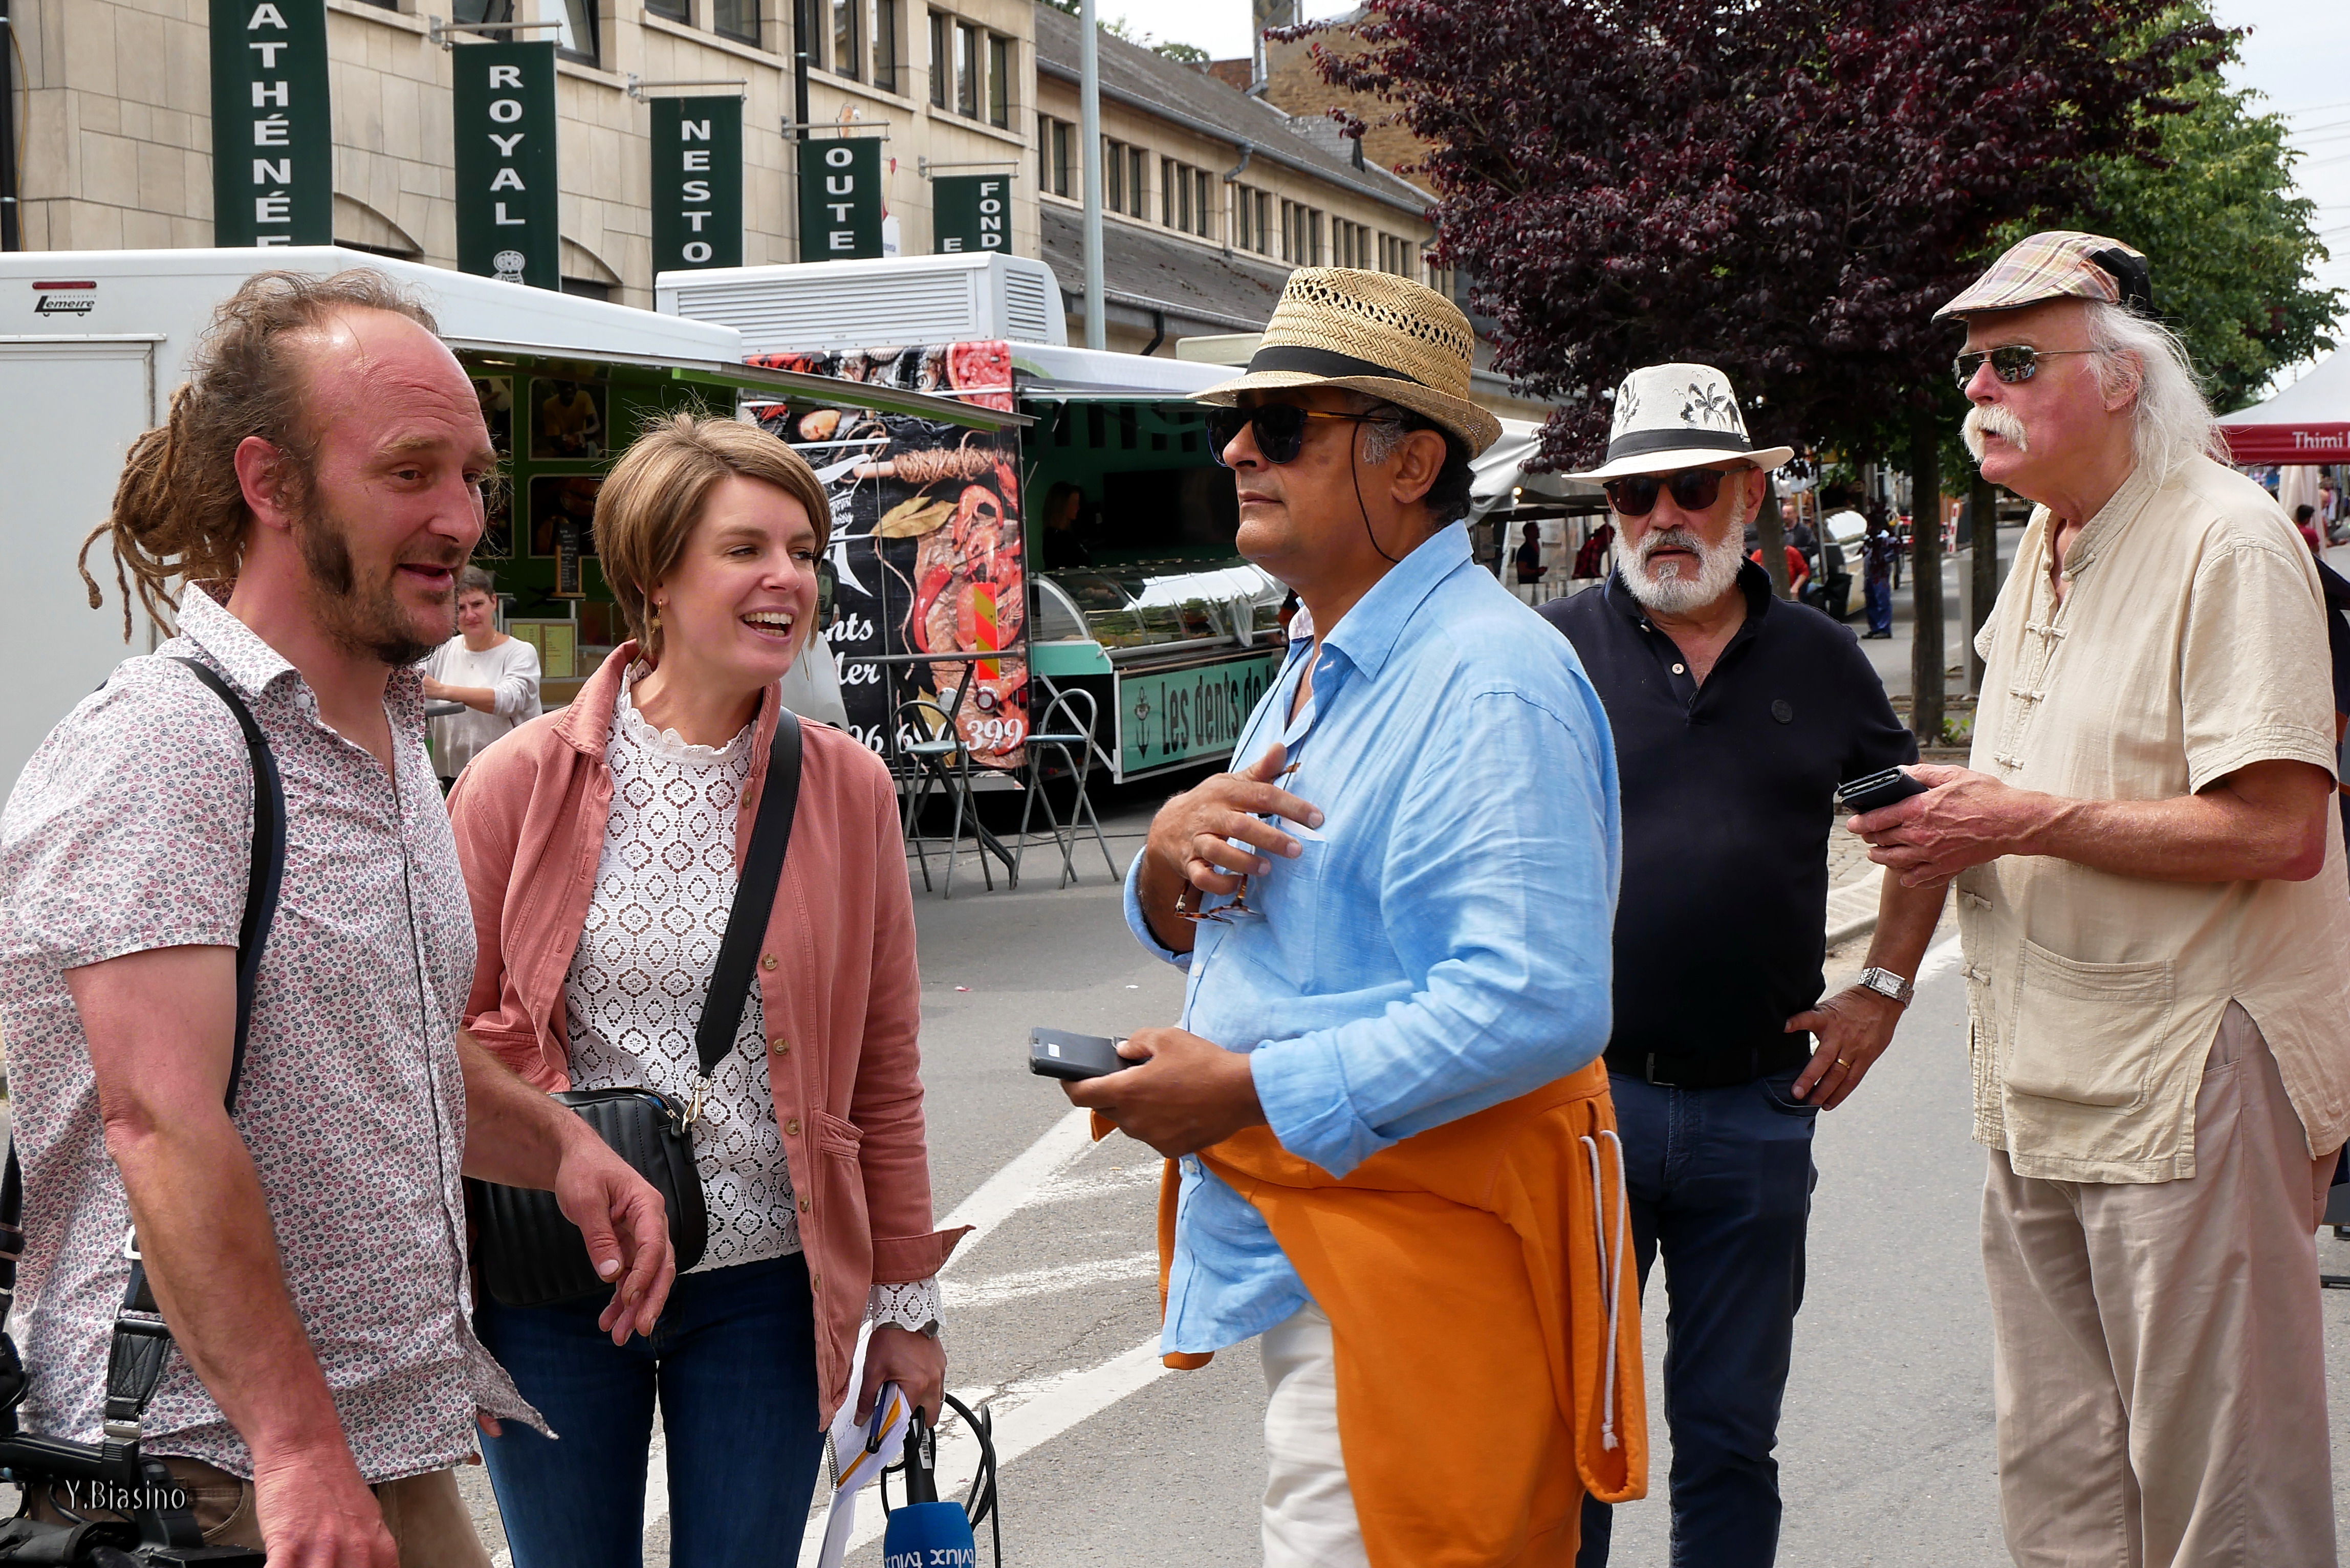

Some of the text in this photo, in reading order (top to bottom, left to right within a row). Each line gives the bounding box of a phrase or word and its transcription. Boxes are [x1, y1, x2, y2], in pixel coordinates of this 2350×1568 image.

[488, 65, 526, 226] ROYAL
[682, 119, 712, 263] NESTO
[825, 147, 855, 262] OUTE
[979, 182, 1002, 252] FOND
[34, 295, 95, 313] Lemeire
[2292, 431, 2343, 449] Thimi
[824, 612, 874, 642] nts
[965, 718, 1023, 751] 399
[1161, 681, 1190, 755] Les
[1195, 671, 1239, 747] dents
[929, 1548, 975, 1568] tvlux
